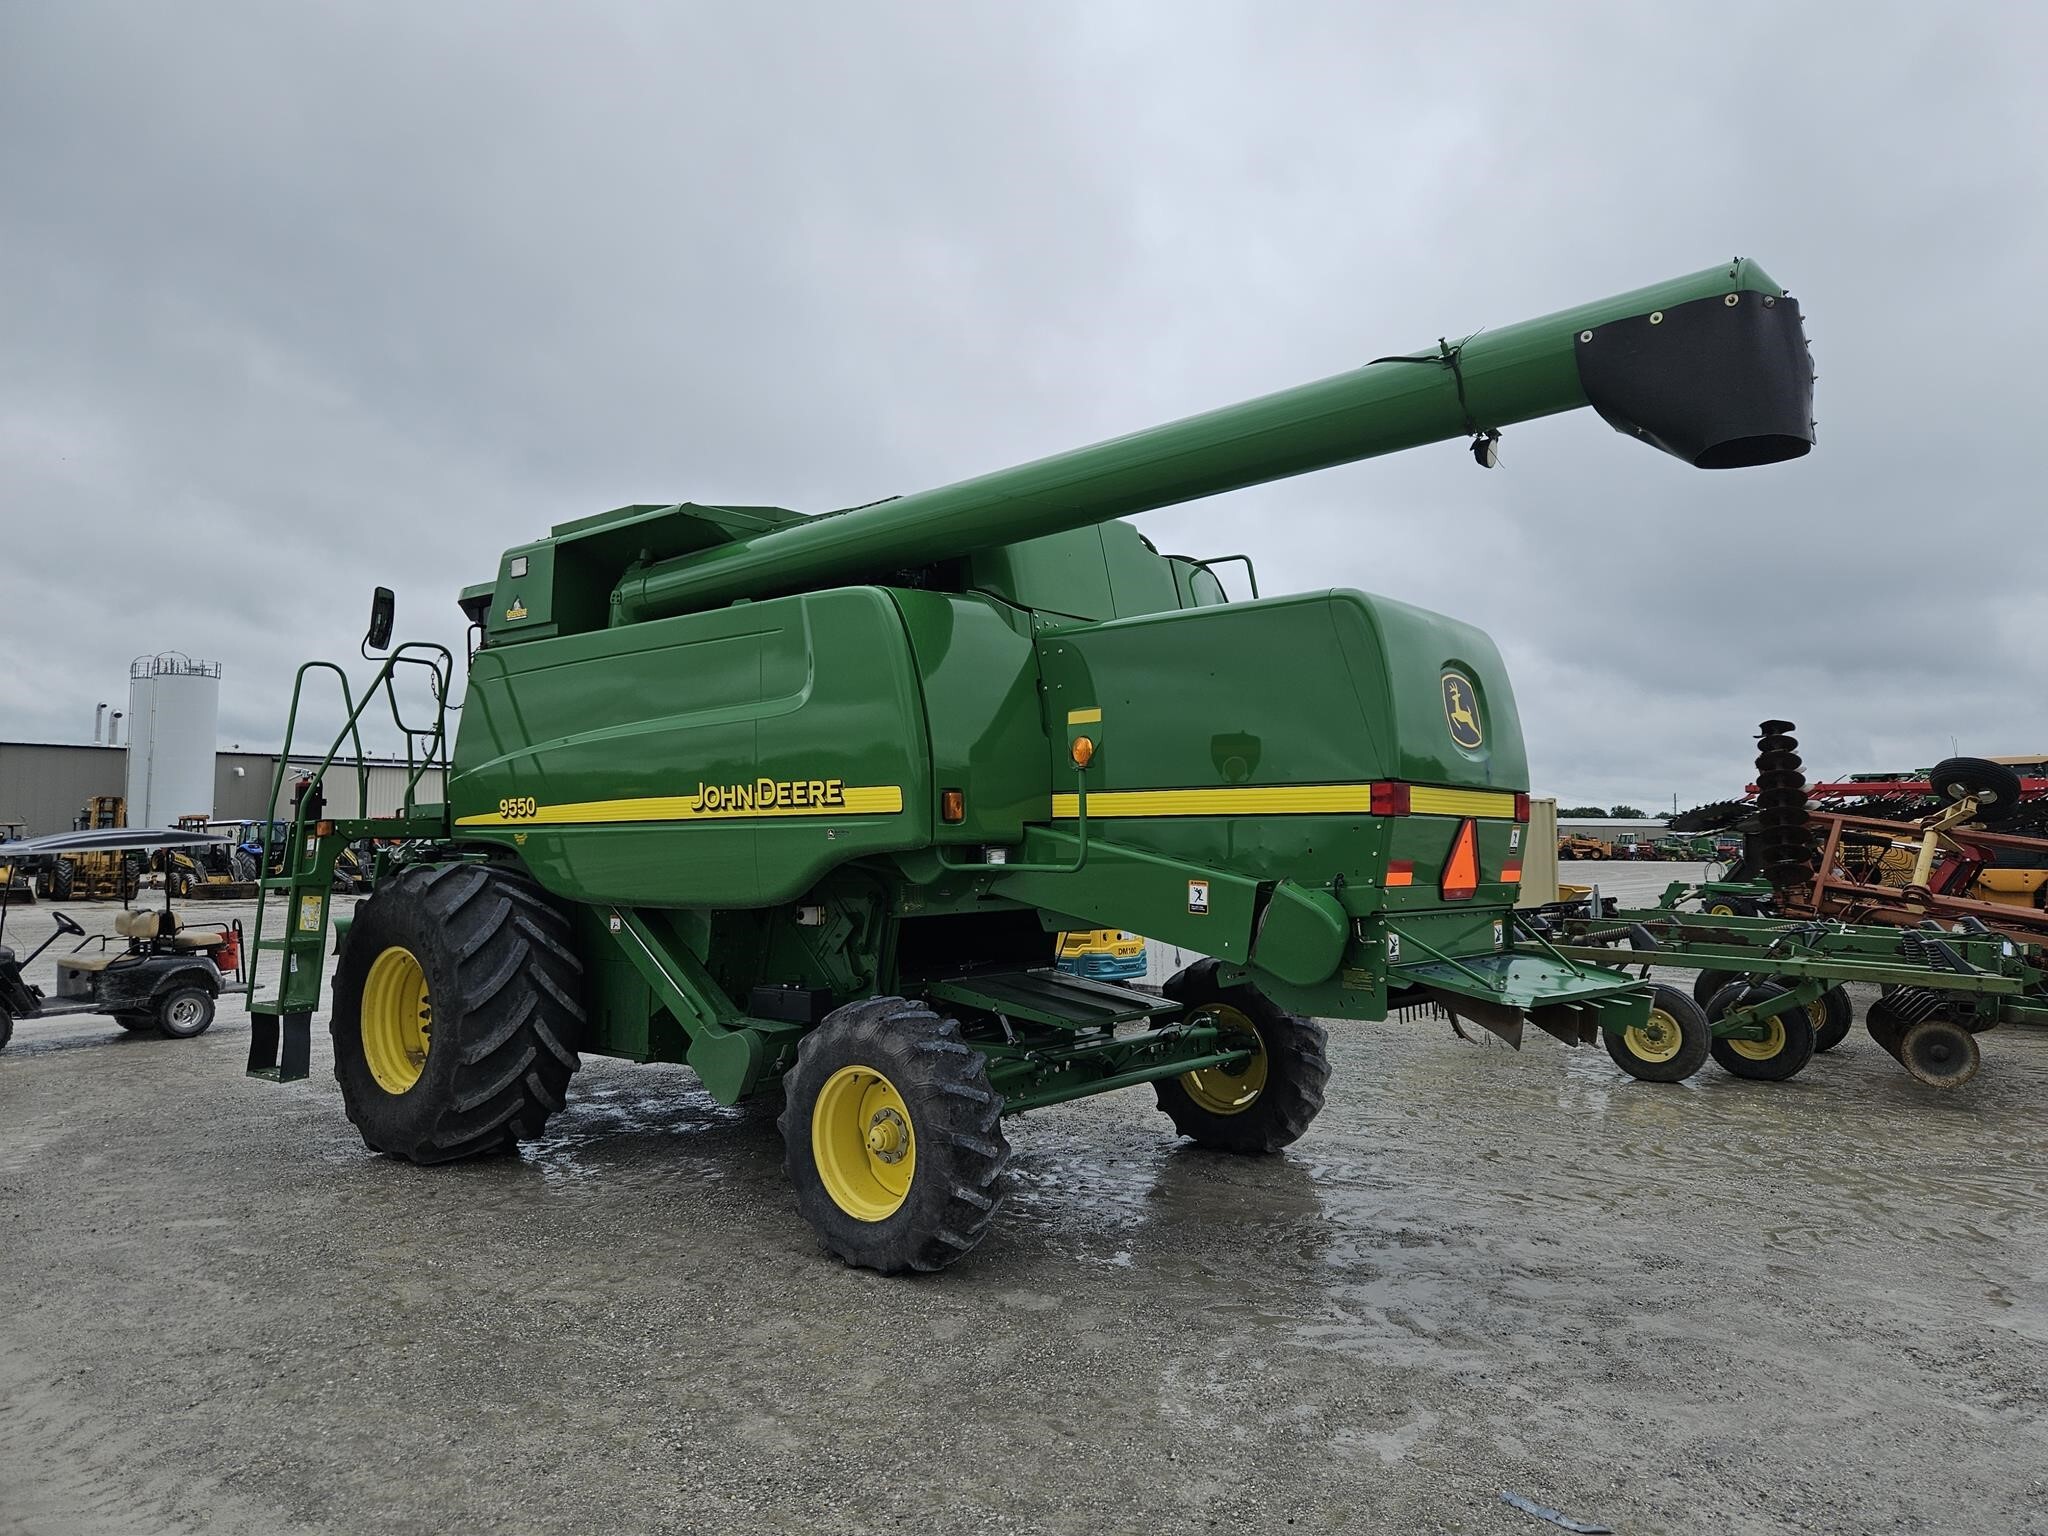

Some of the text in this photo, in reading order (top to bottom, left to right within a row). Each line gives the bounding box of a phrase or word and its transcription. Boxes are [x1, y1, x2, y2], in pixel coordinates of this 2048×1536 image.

[499, 796, 536, 818] 9550
[691, 778, 845, 812] JOHN DEERE
